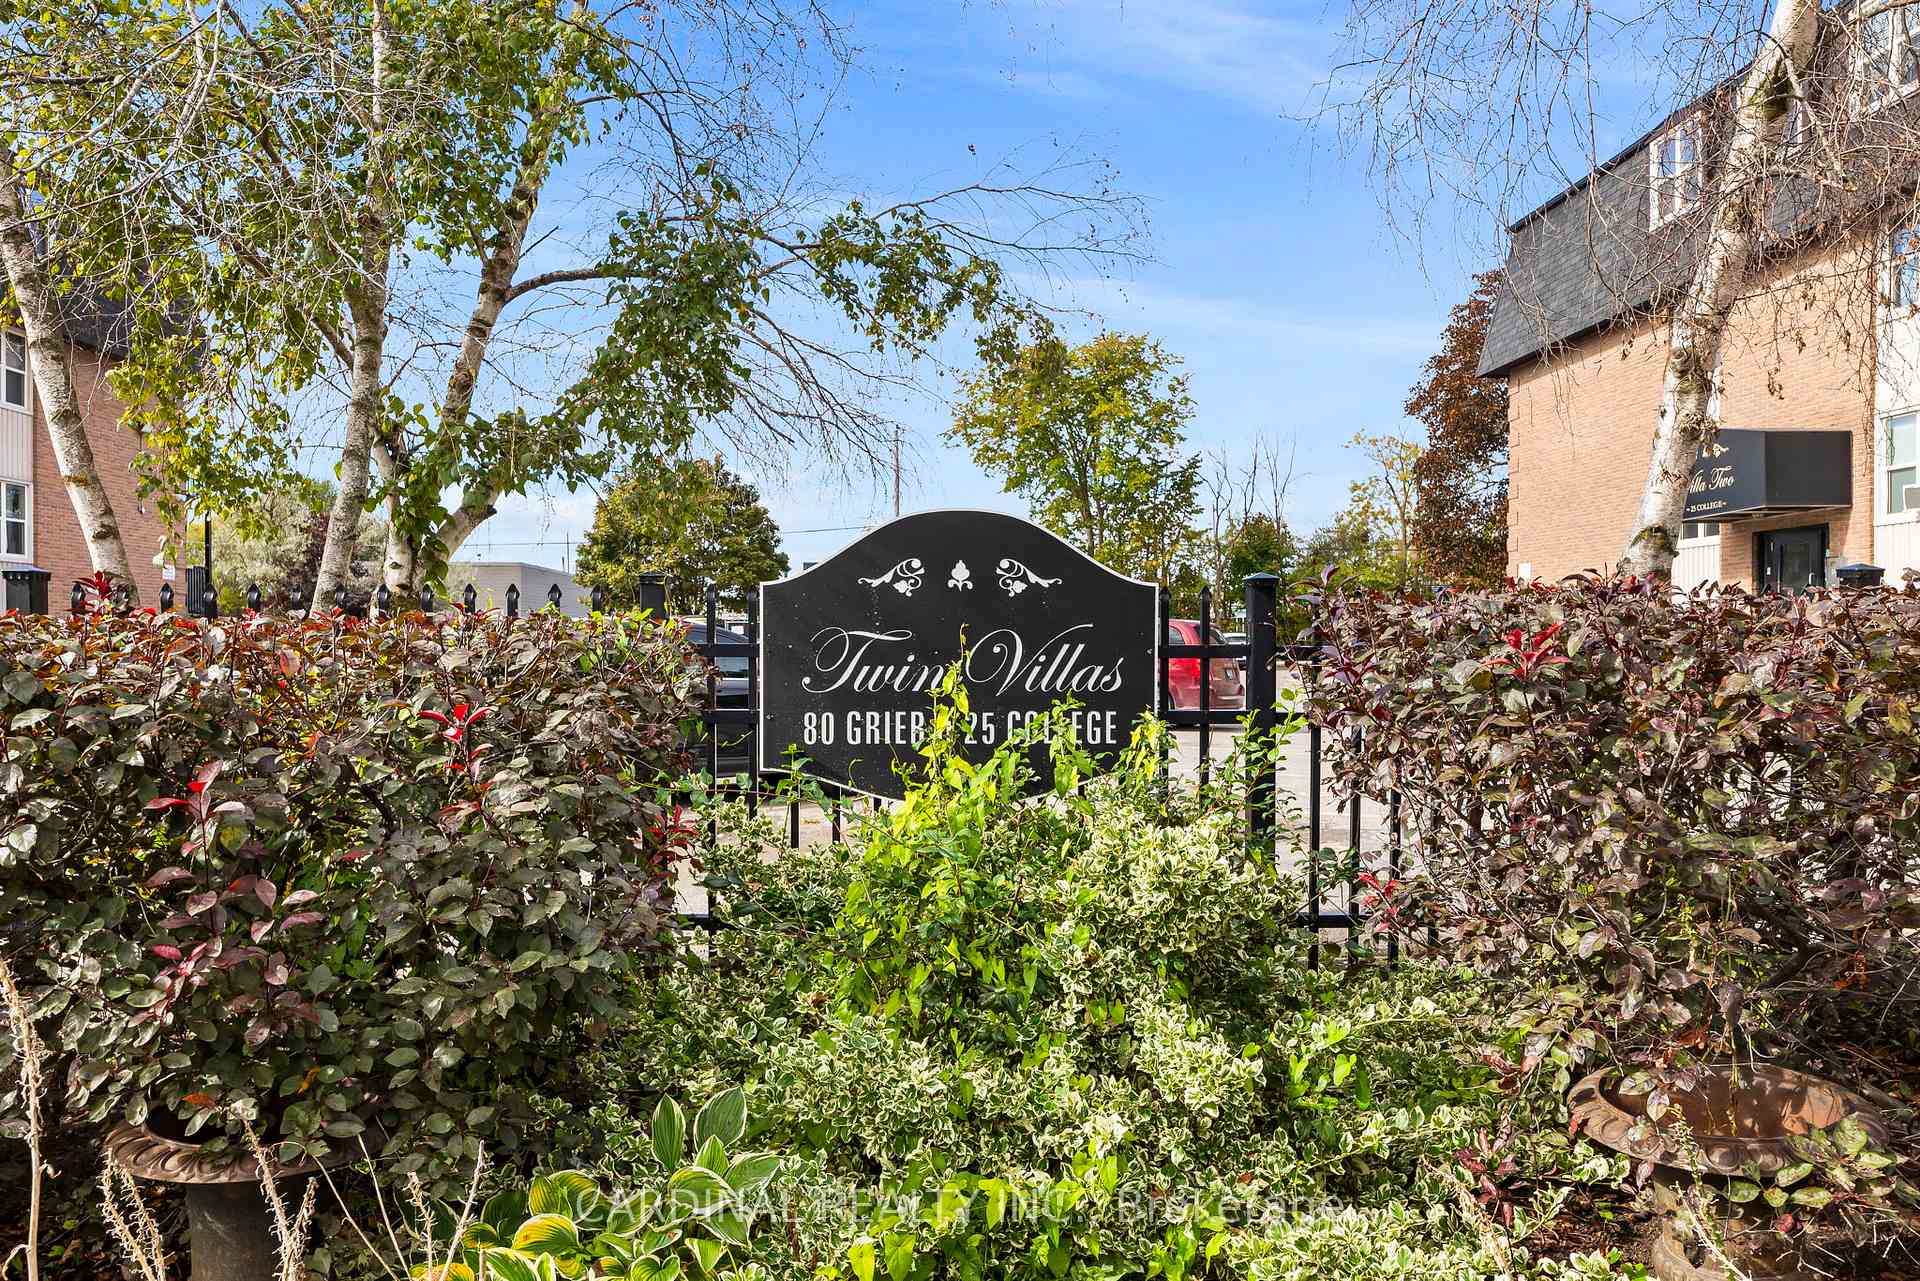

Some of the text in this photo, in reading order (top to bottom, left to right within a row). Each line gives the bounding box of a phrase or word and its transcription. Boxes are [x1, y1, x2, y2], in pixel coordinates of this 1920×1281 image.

[1689, 465, 1735, 494] illa Two
[802, 623, 1124, 697] Twin Villas
[804, 711, 835, 745] 80
[964, 711, 995, 744] 25
